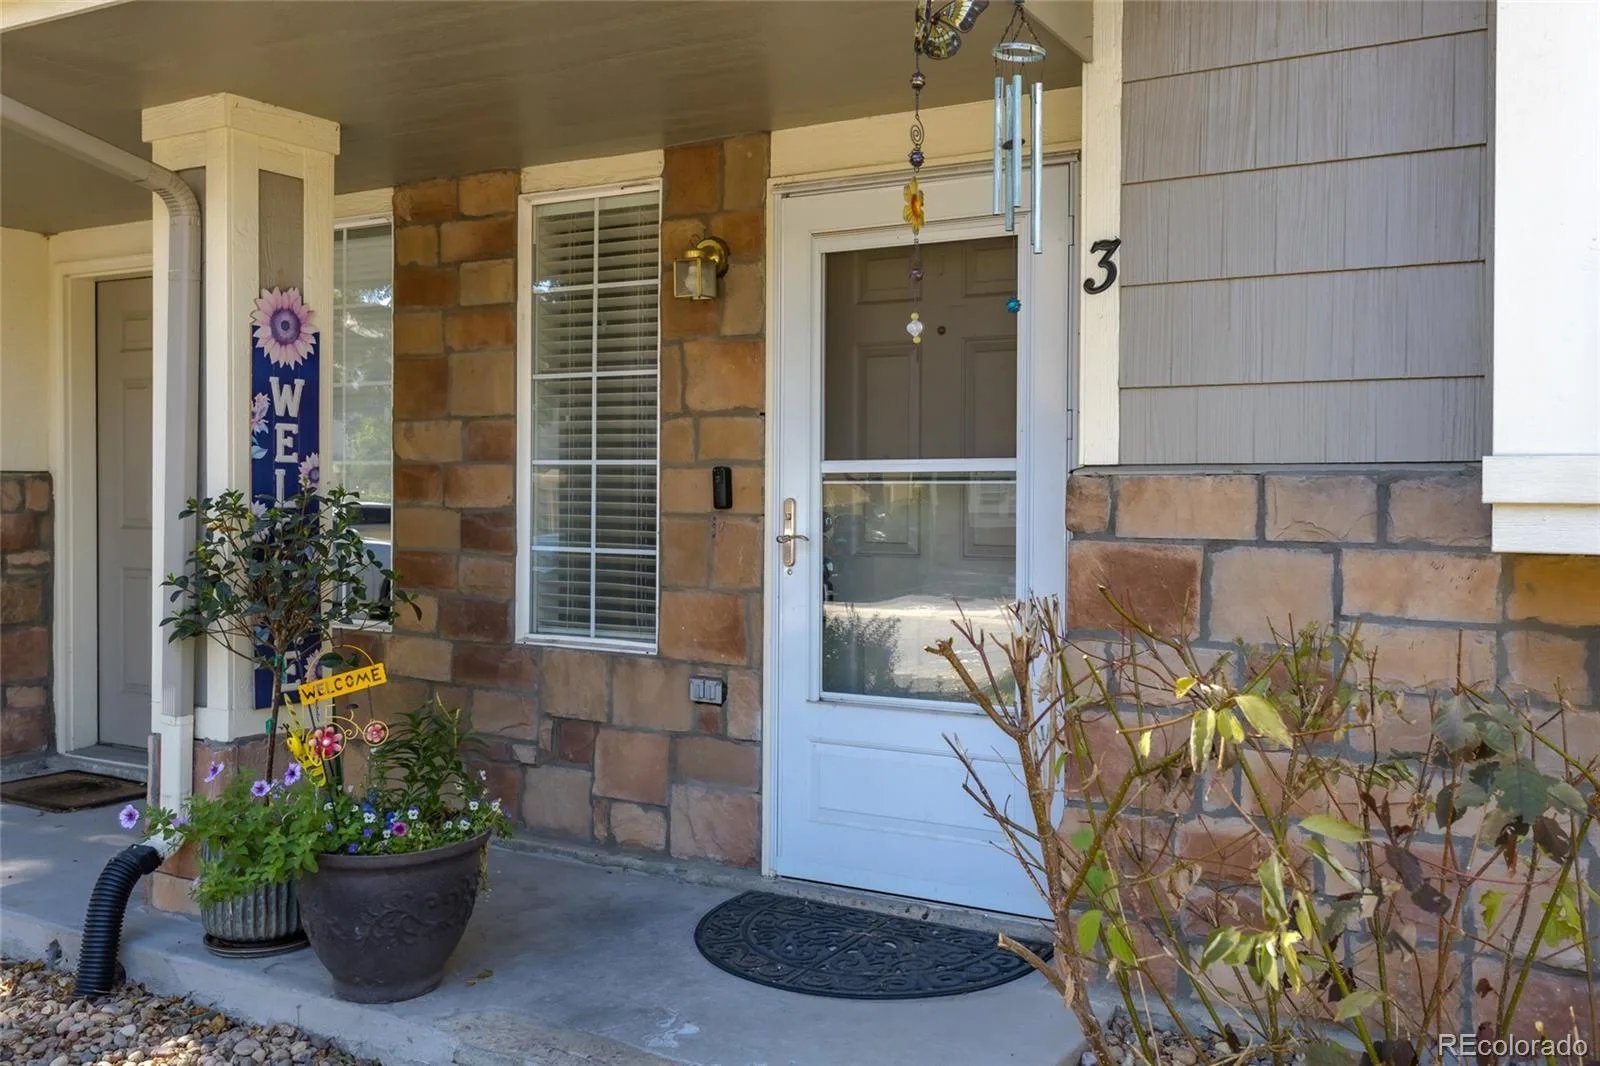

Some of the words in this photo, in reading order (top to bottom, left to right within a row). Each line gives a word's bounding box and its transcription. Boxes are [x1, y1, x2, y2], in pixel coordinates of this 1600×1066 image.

[1083, 238, 1121, 295] 3
[269, 376, 305, 692] WELE
[302, 668, 382, 699] WELCOME
